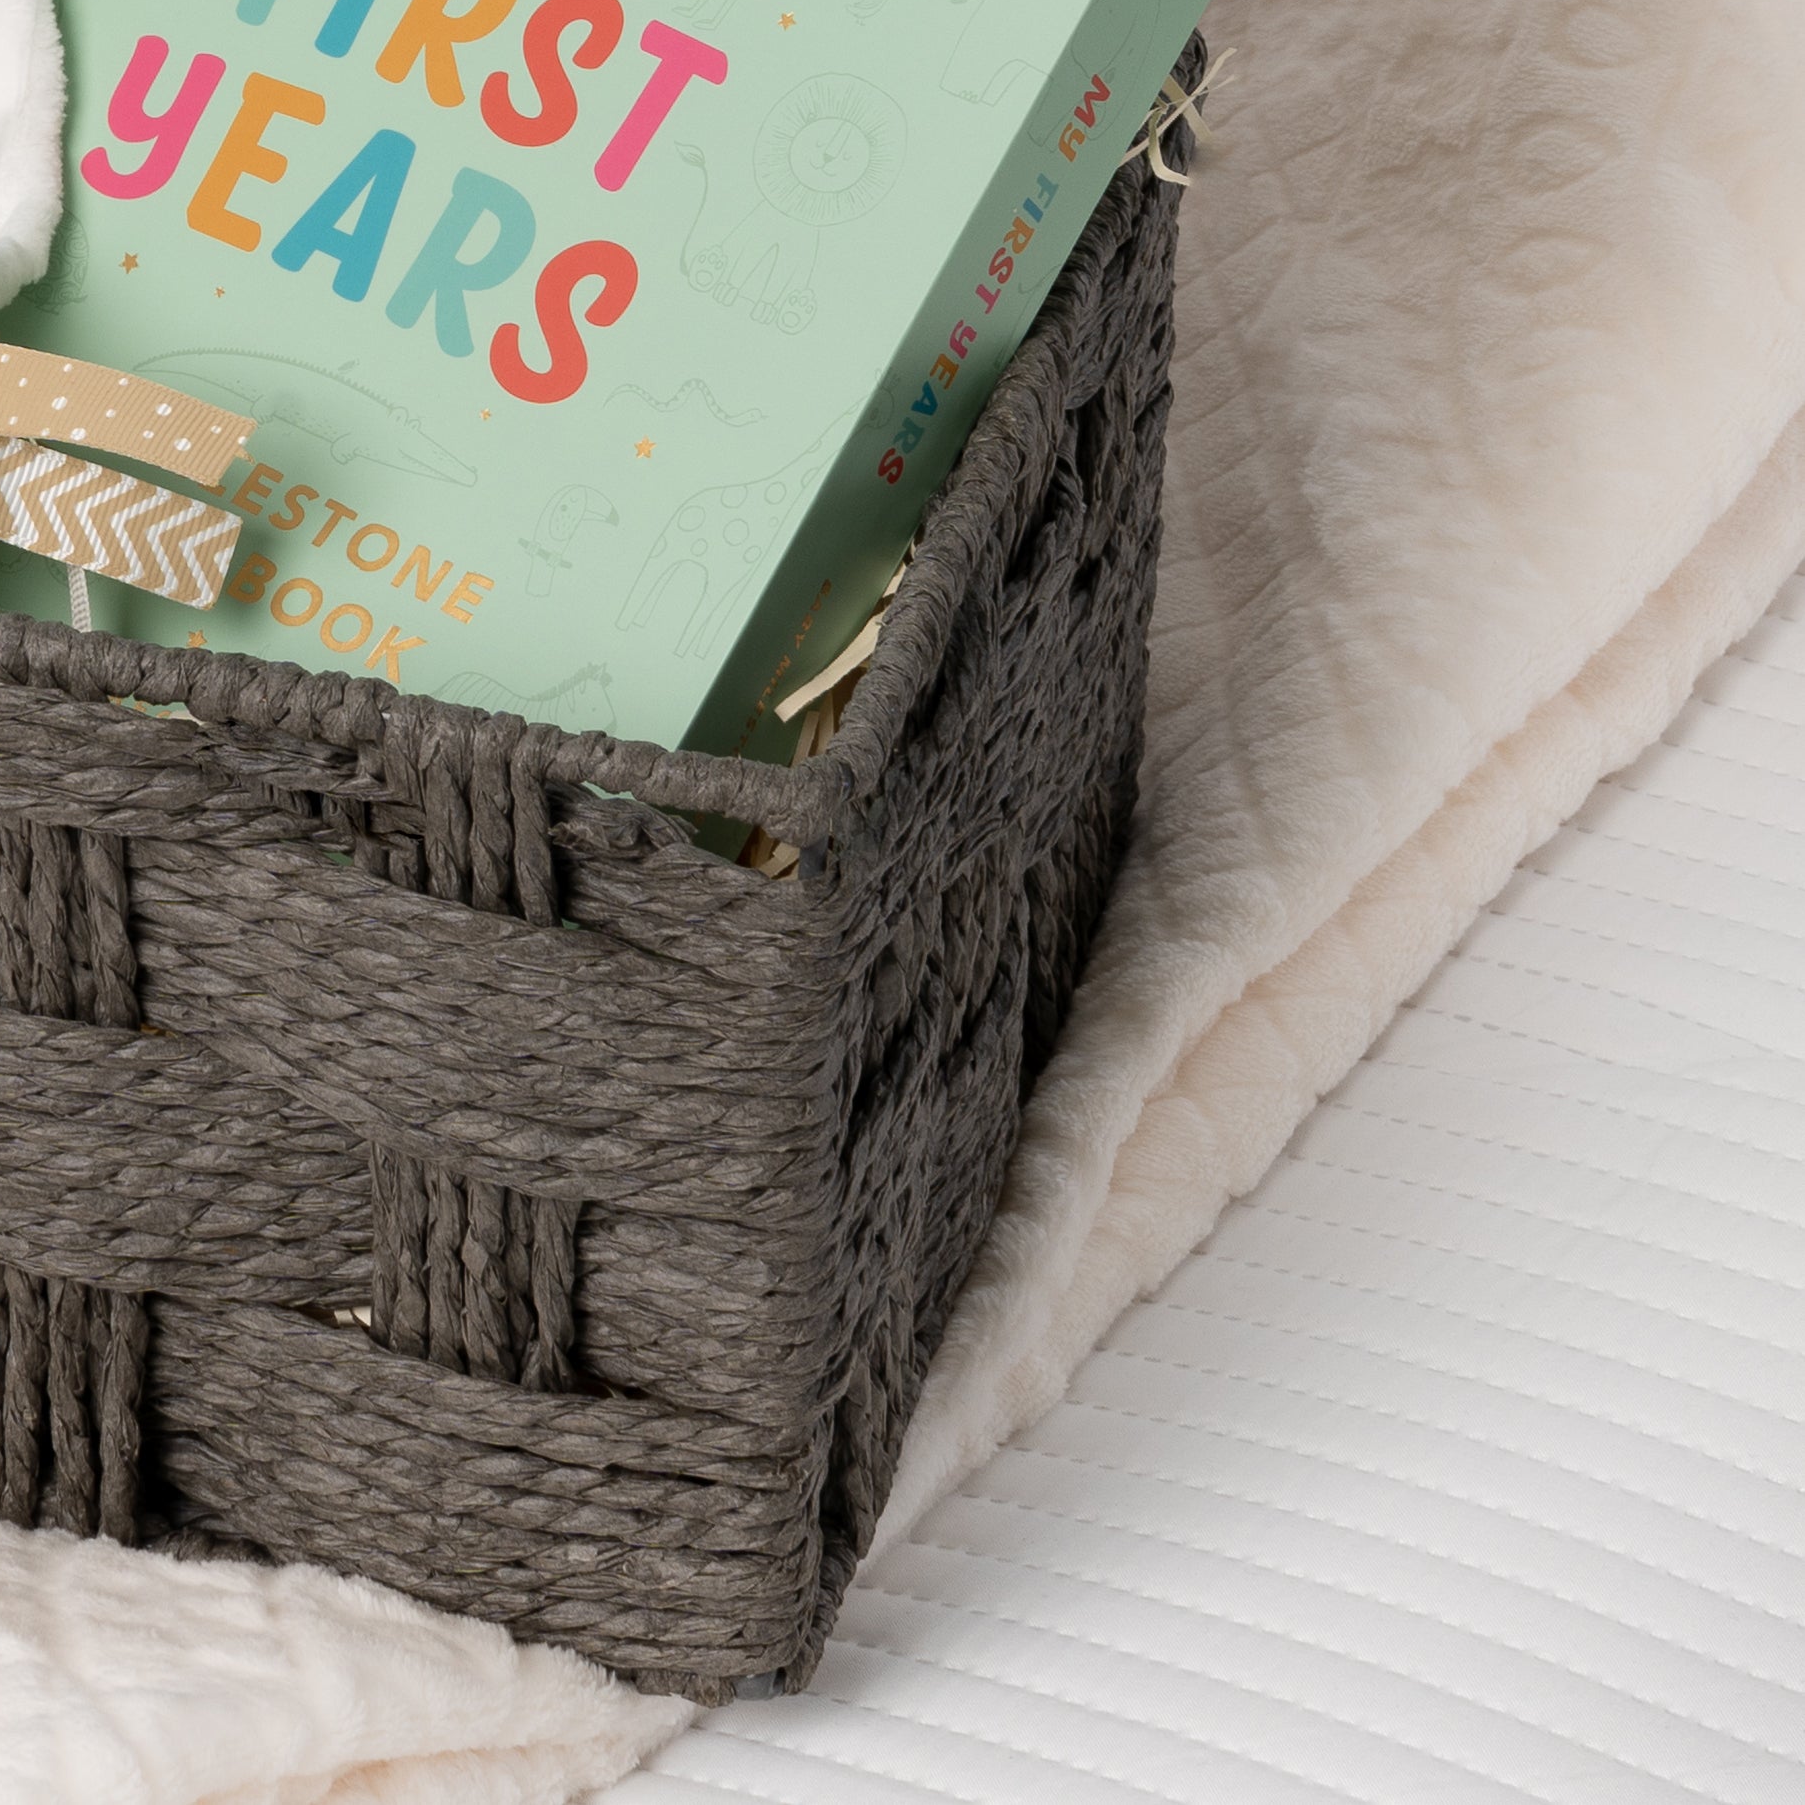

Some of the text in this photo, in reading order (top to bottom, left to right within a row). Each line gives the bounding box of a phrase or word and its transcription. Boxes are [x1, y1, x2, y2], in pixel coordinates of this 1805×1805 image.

[975, 172, 1060, 315] FIRST
[197, 462, 495, 625] ESTONE
[226, 552, 428, 684] BOOK
